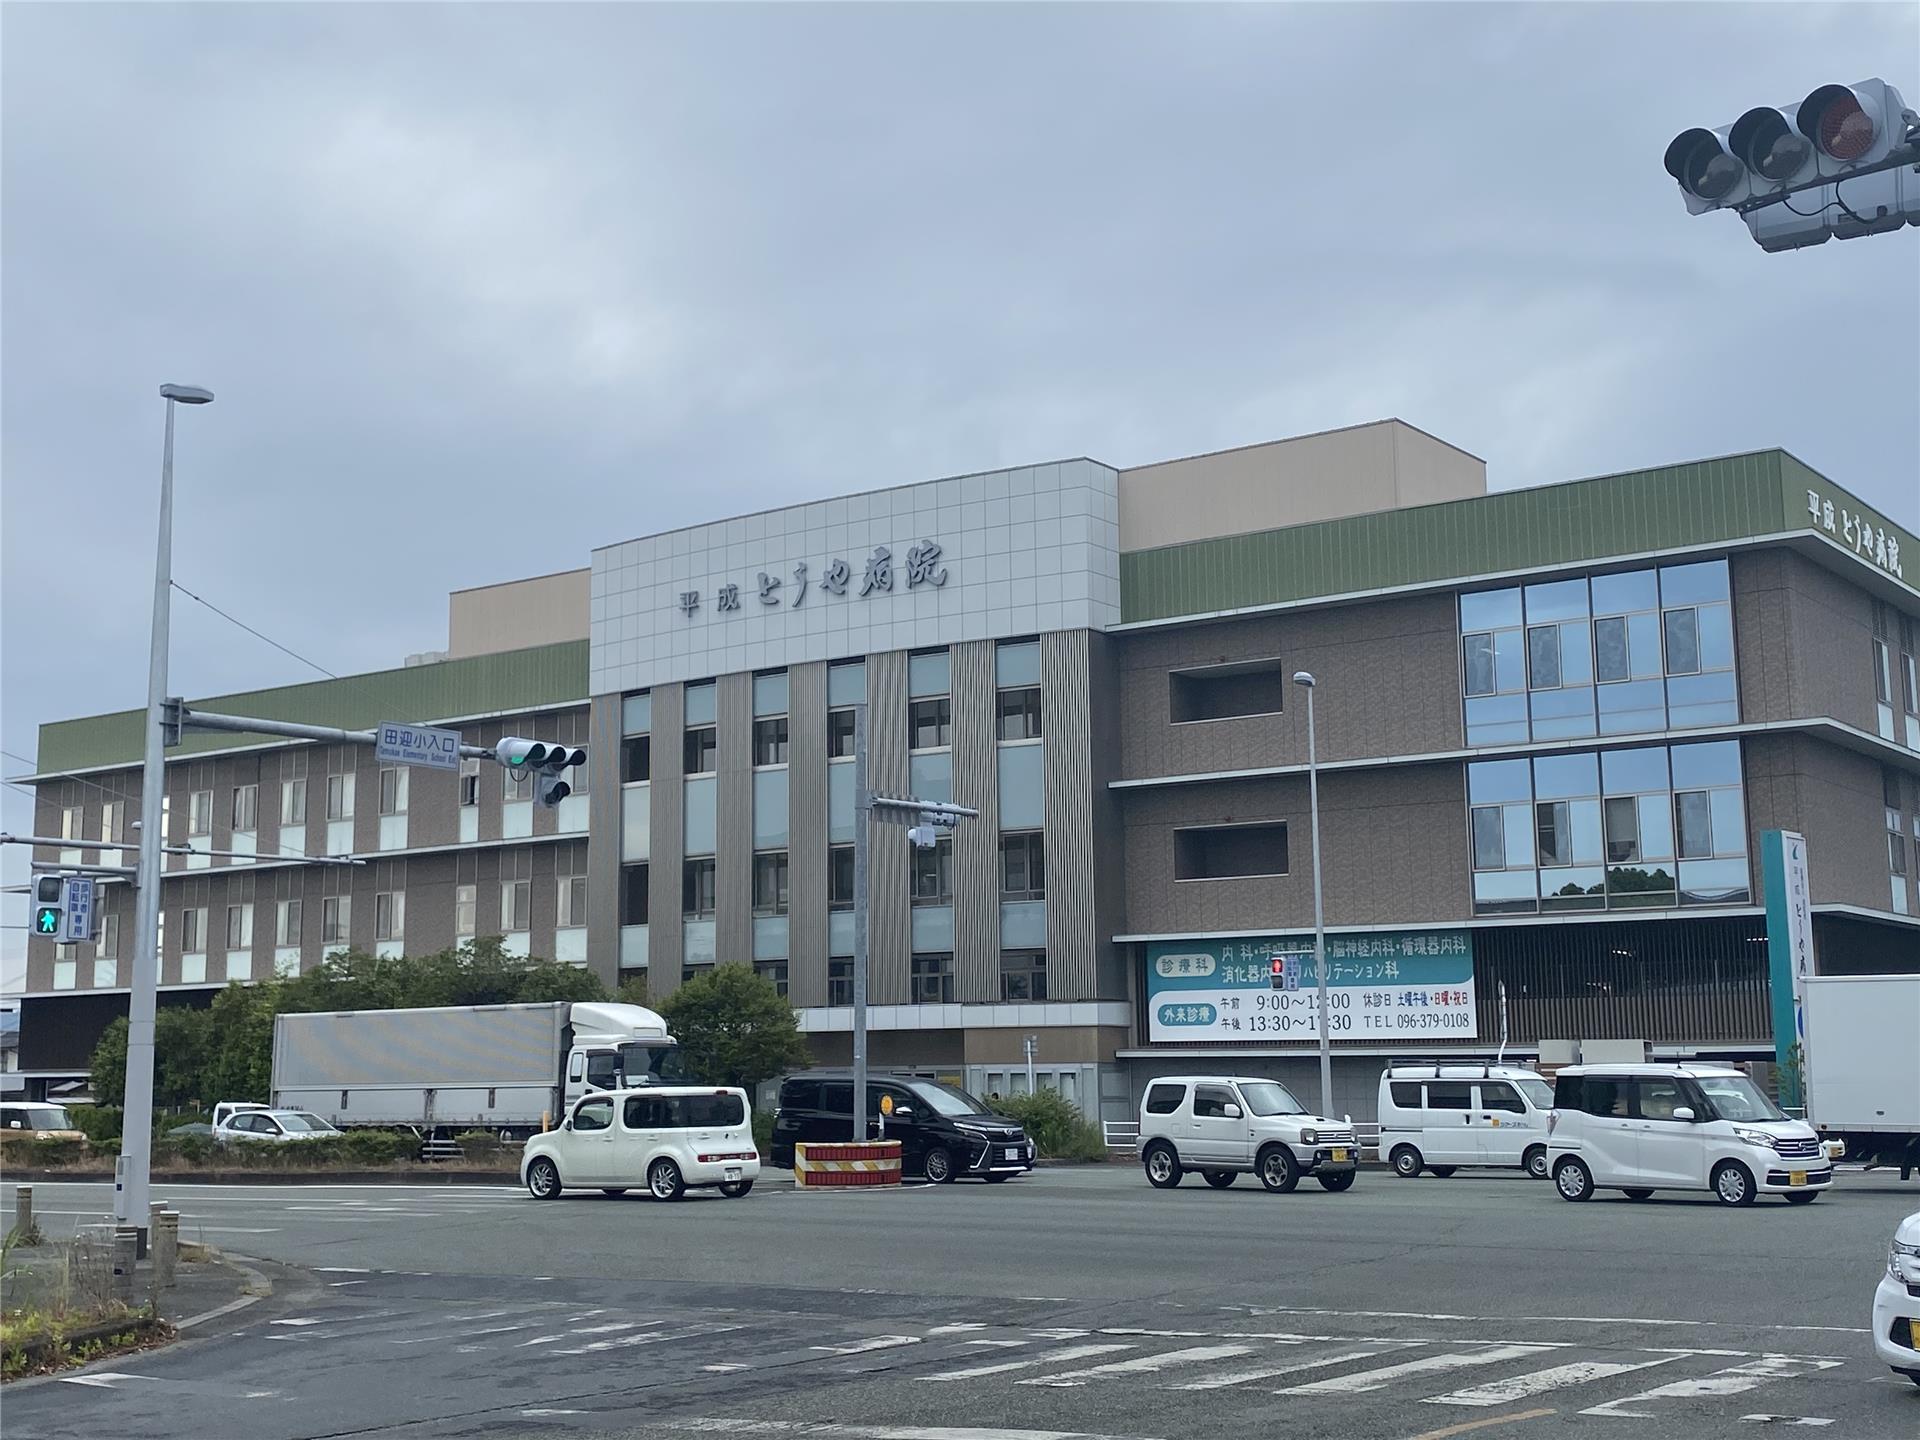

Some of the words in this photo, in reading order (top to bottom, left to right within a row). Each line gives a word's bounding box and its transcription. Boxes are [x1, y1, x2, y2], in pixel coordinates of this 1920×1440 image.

[679, 539, 949, 617] 平成とうや病院
[385, 729, 455, 753] 田迎小入口
[1161, 958, 1209, 974] 診療科
[1220, 998, 1240, 1010] 午前
[1363, 992, 1391, 1008] 休診日
[1164, 1006, 1210, 1023] 外来診療
[1221, 1017, 1241, 1031] 午後
[1249, 1014, 1352, 1031] 13:30～1:30
[1364, 1015, 1392, 1028] TEL
[1397, 1012, 1470, 1028] 096-379-0108
